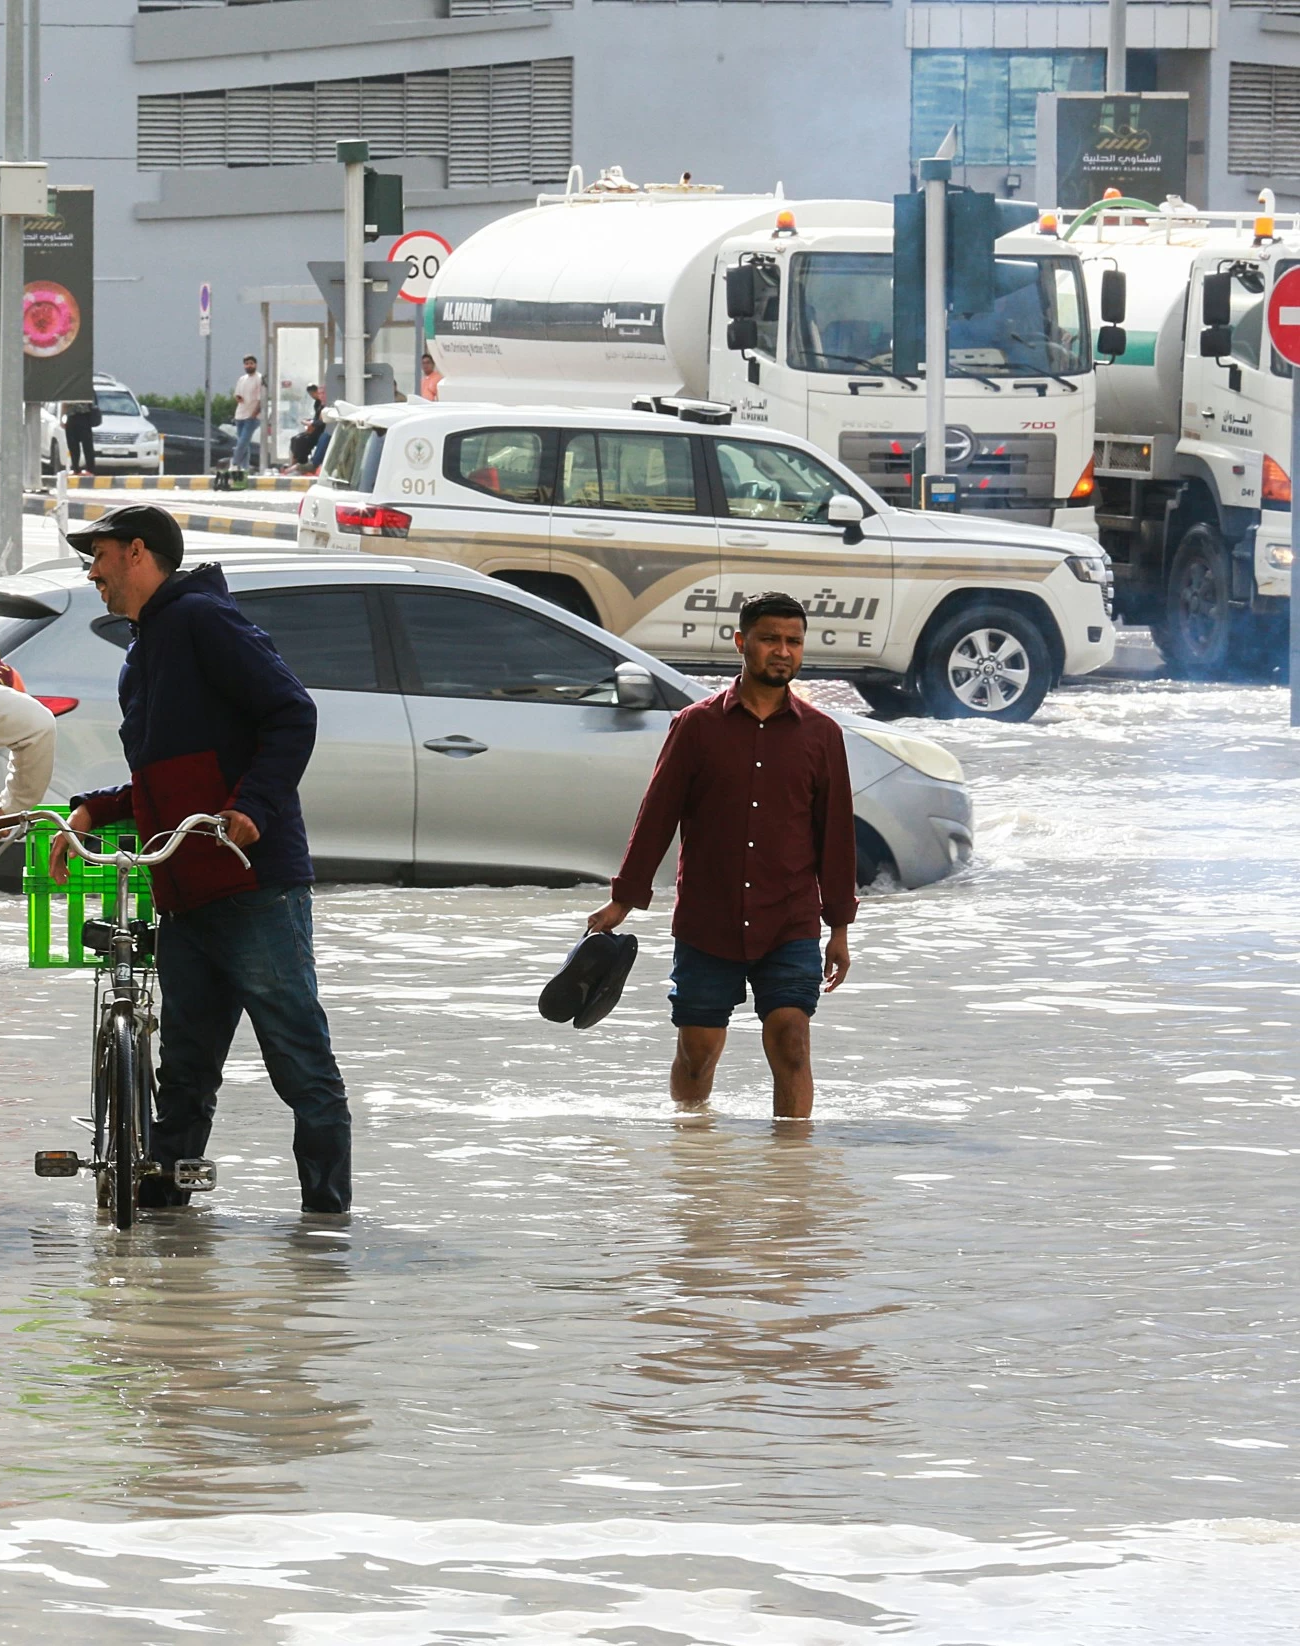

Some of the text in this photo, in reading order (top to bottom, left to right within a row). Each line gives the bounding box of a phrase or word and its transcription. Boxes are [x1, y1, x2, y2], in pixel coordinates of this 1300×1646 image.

[1082, 153, 1162, 166] المشاوي الحلبية
[405, 254, 440, 279] 60
[452, 321, 482, 331] CONSTRUCT
[1020, 421, 1056, 430] 700
[401, 477, 436, 496] 901
[681, 622, 872, 647] POCE
